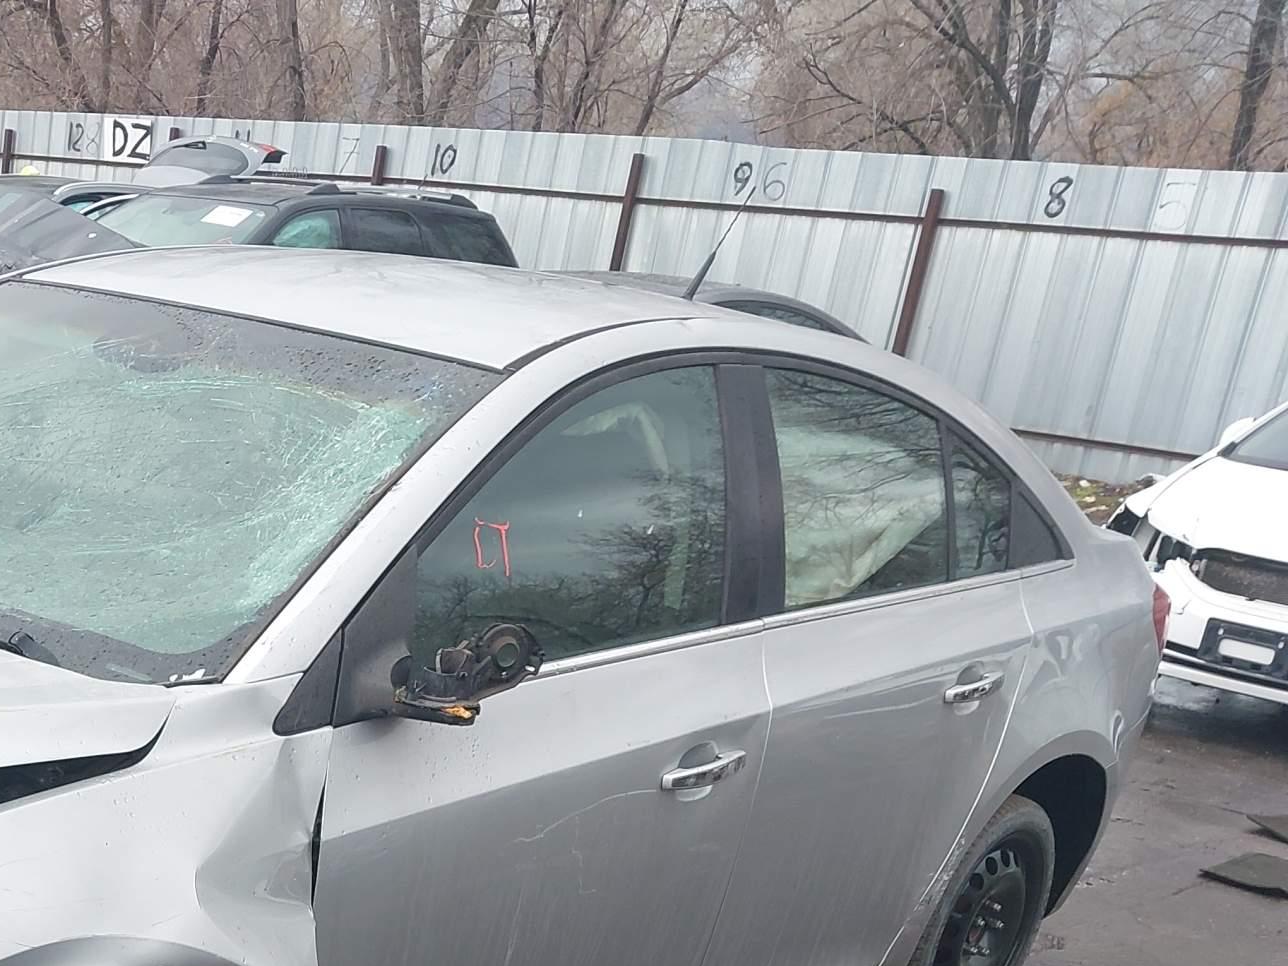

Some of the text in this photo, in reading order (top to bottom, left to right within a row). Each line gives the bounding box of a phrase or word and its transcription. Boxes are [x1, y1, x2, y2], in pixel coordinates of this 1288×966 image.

[67, 120, 84, 152] 12
[112, 118, 153, 161] DZ
[430, 142, 457, 177] 10
[733, 161, 753, 197] 9
[763, 162, 788, 202] 6
[1043, 175, 1074, 219] 8
[1154, 181, 1197, 232] 5
